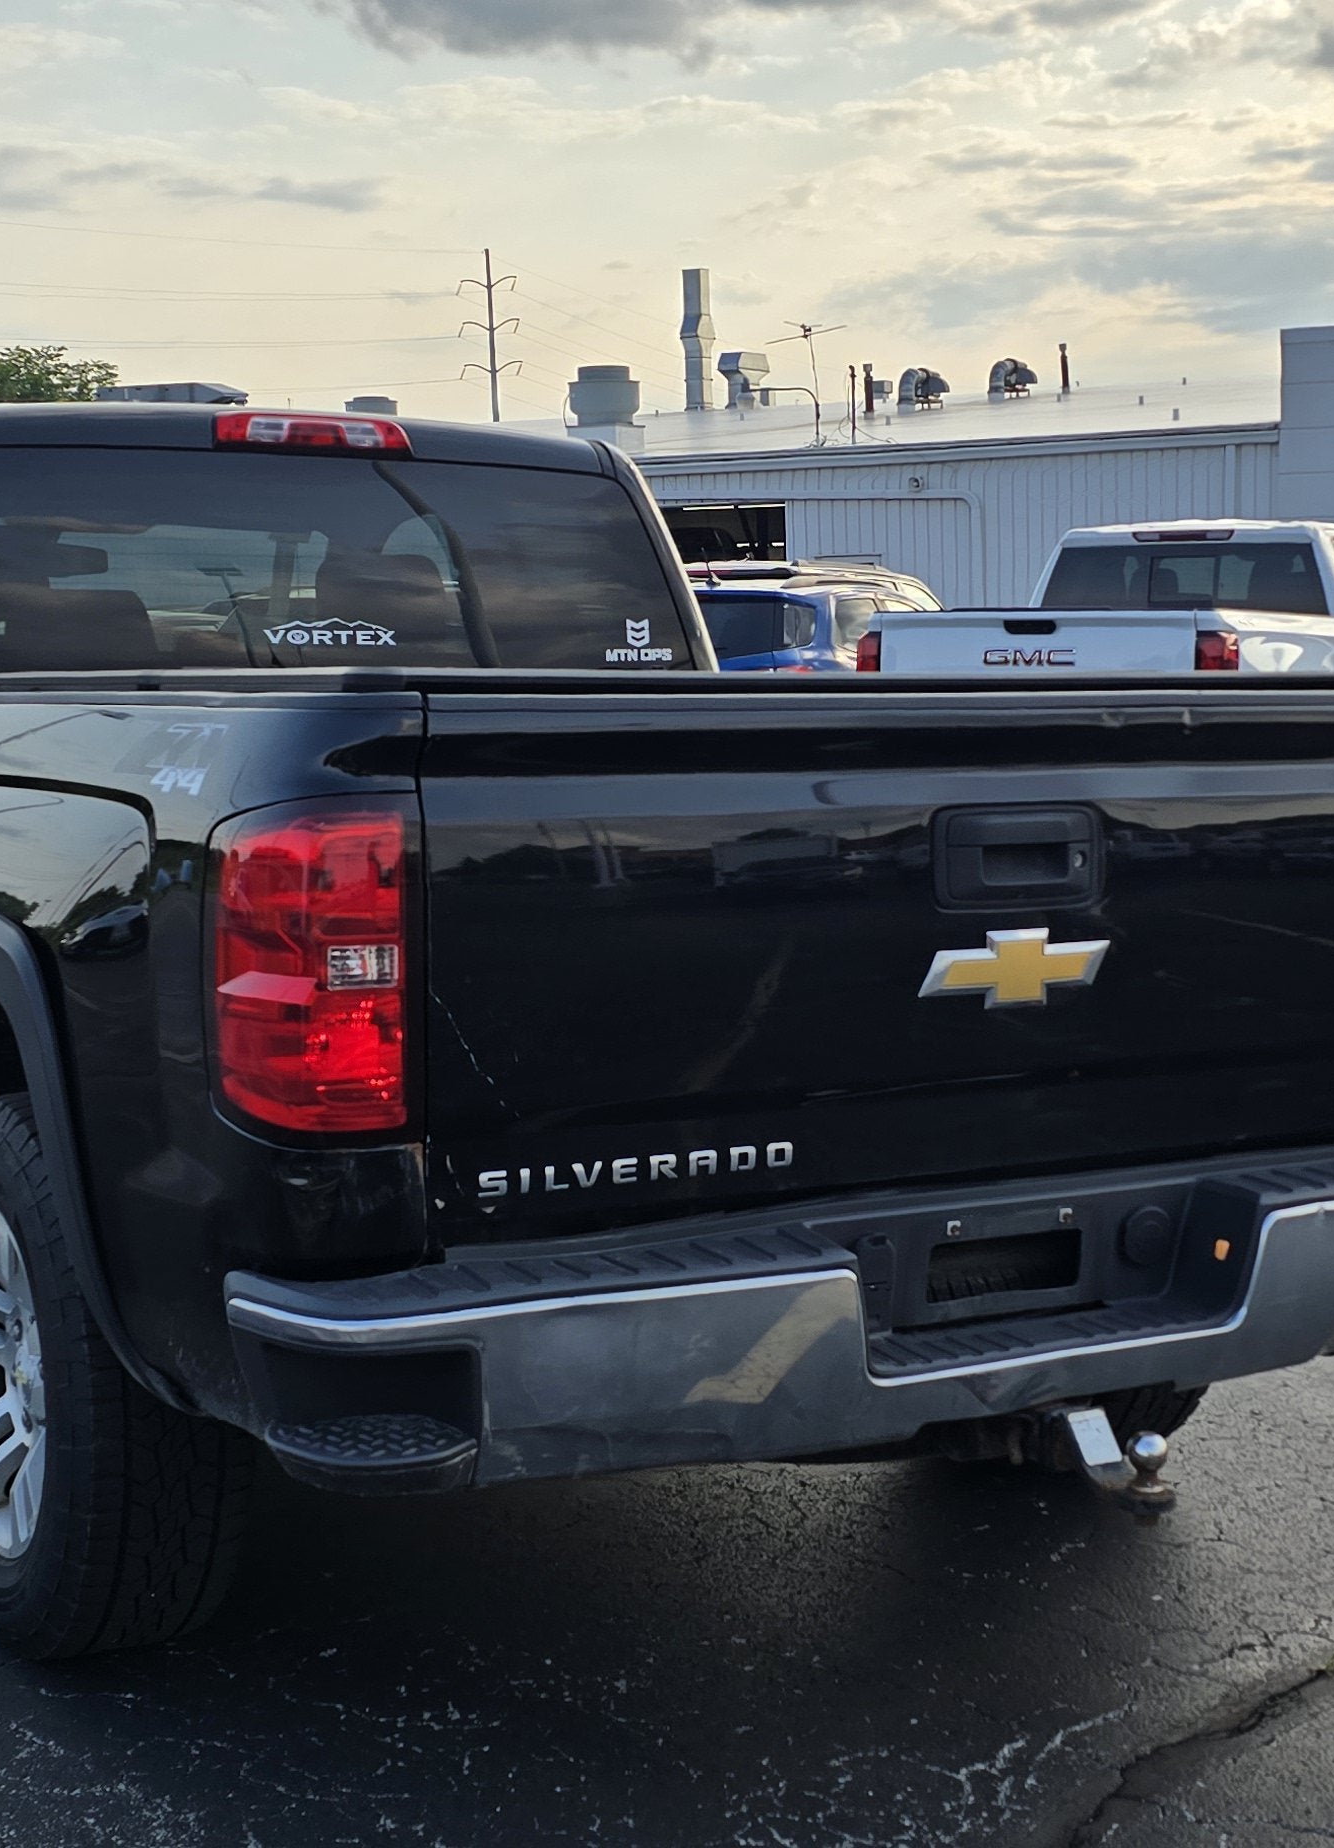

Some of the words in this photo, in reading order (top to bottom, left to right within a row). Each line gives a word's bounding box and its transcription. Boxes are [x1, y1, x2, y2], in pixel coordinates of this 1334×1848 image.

[262, 629, 397, 646] VORTEX
[605, 648, 639, 662] MTN
[640, 647, 673, 662] OPS
[982, 648, 1076, 667] GMC
[477, 1141, 794, 1198] SILVERADO
